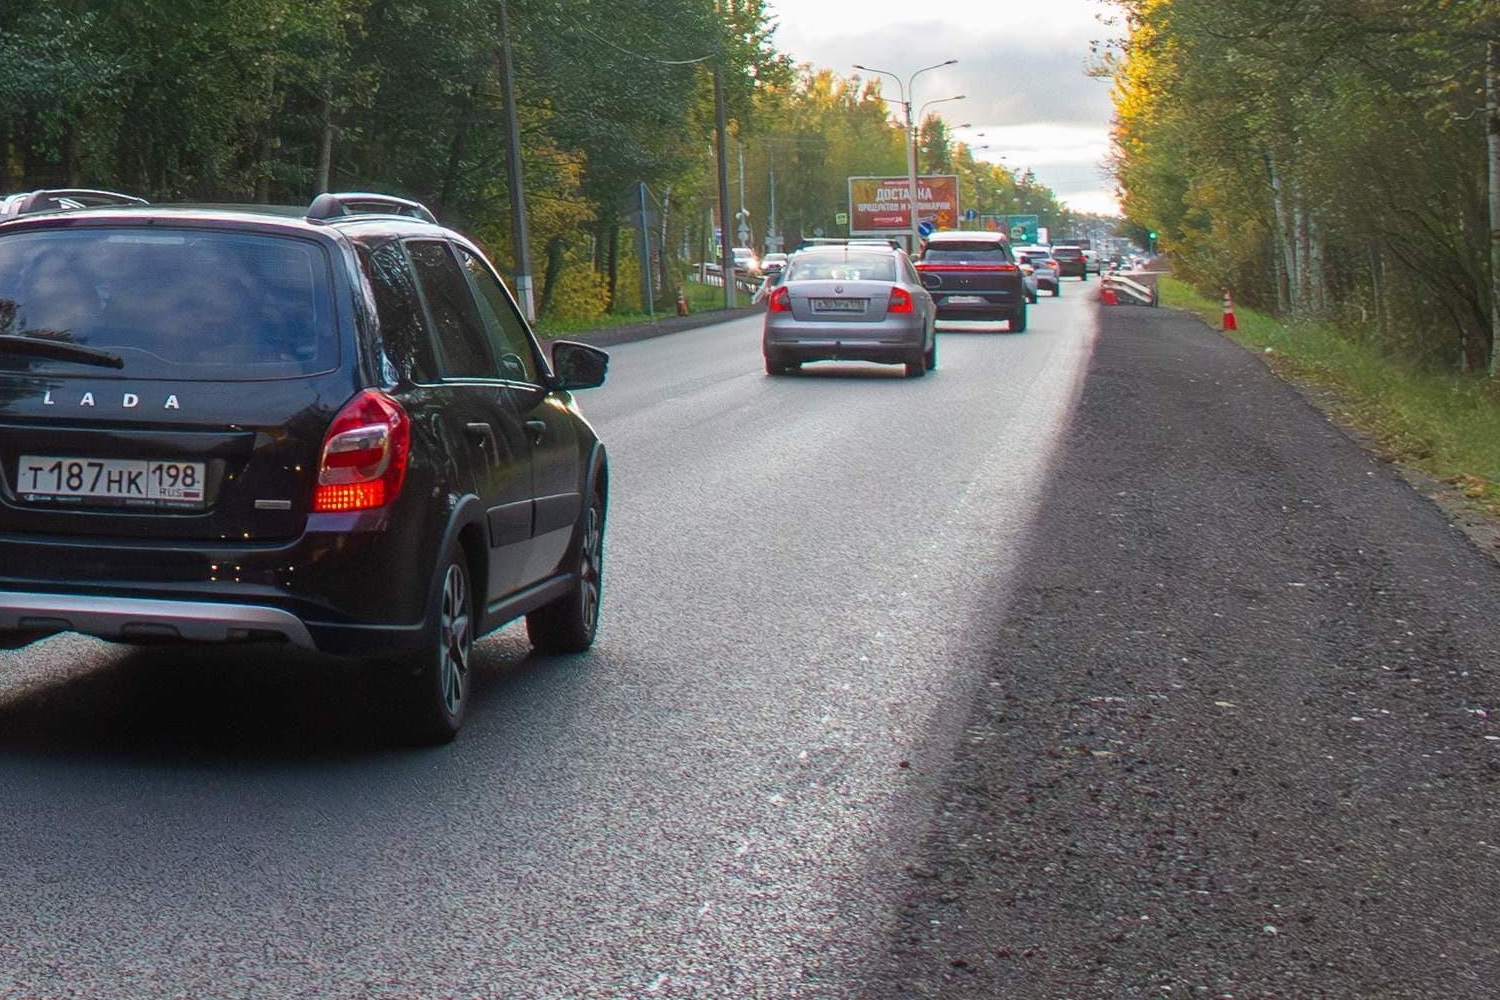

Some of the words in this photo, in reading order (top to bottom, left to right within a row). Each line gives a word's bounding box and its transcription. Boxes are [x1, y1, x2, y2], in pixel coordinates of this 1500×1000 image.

[876, 188, 933, 202] ДОСТАКА
[43, 391, 180, 409] LADA
[28, 461, 144, 495] Т187НК
[152, 463, 196, 488] 198
[159, 487, 183, 497] RUS
